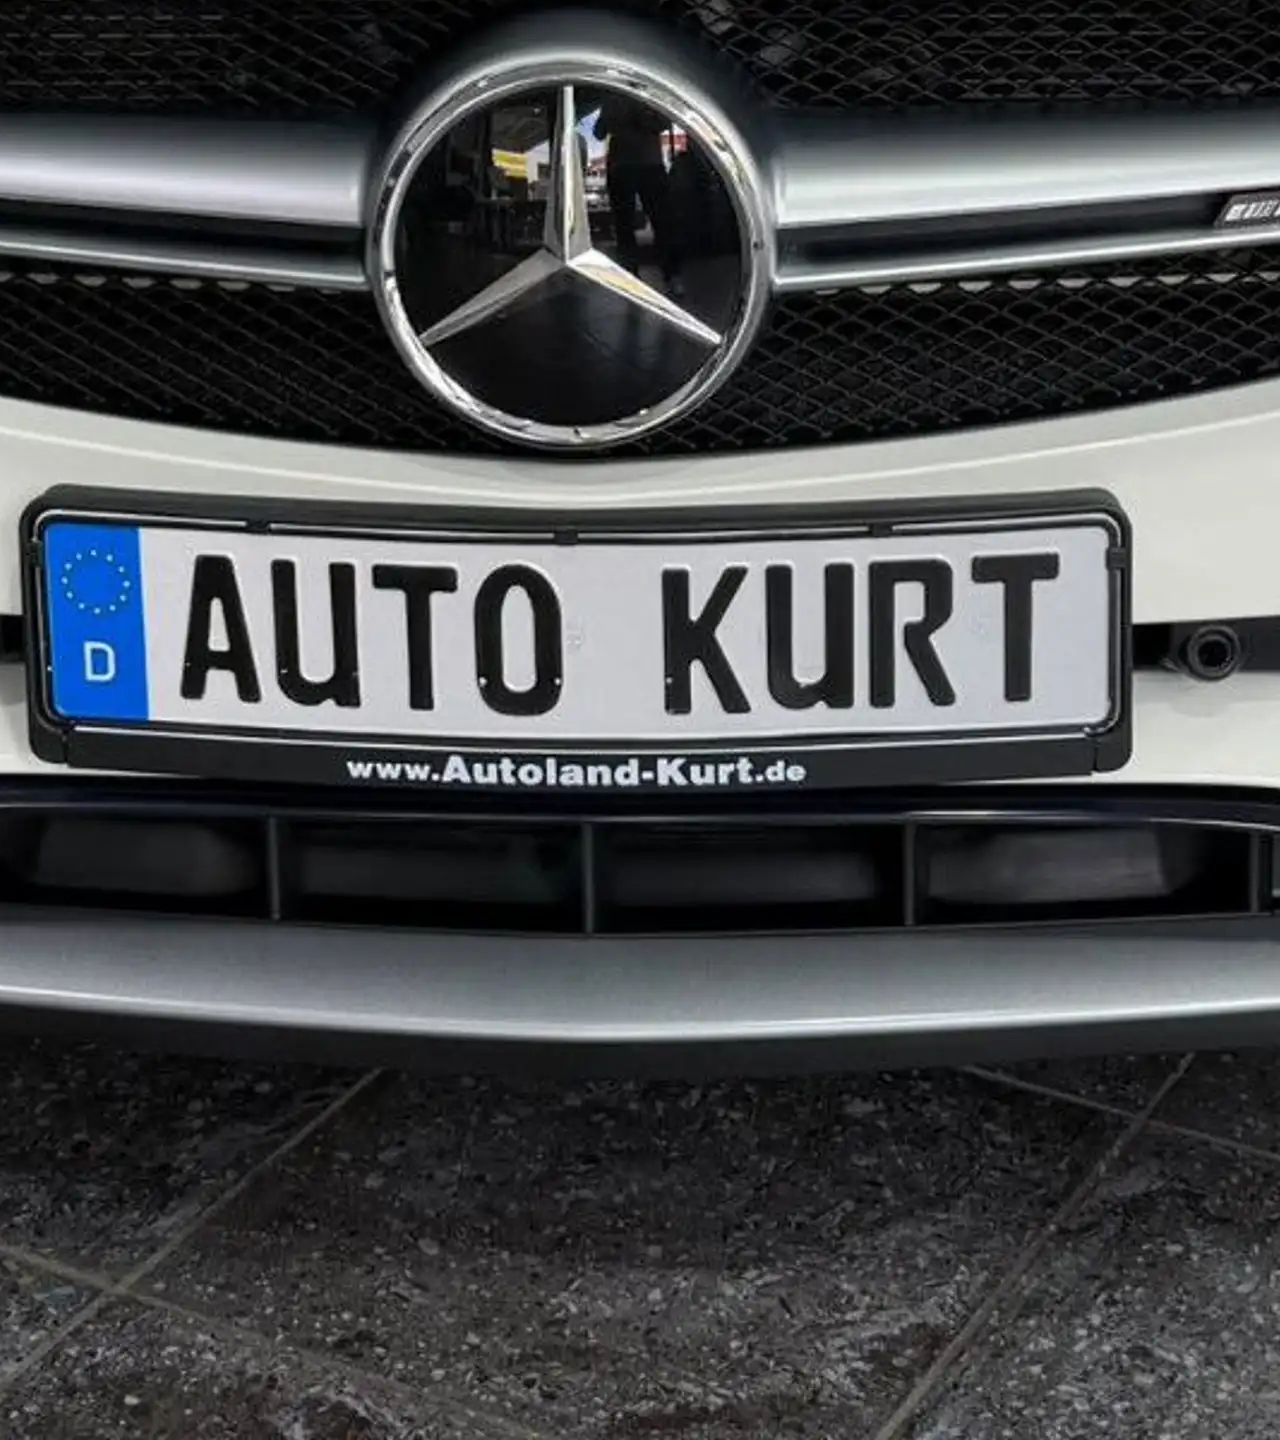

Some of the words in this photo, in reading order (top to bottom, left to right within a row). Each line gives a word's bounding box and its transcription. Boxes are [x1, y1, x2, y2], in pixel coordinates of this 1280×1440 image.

[179, 554, 563, 716] AUTO
[660, 552, 1061, 715] KURT
[83, 641, 117, 682] D
[345, 754, 807, 787] www.Autoland-Kurt.de
